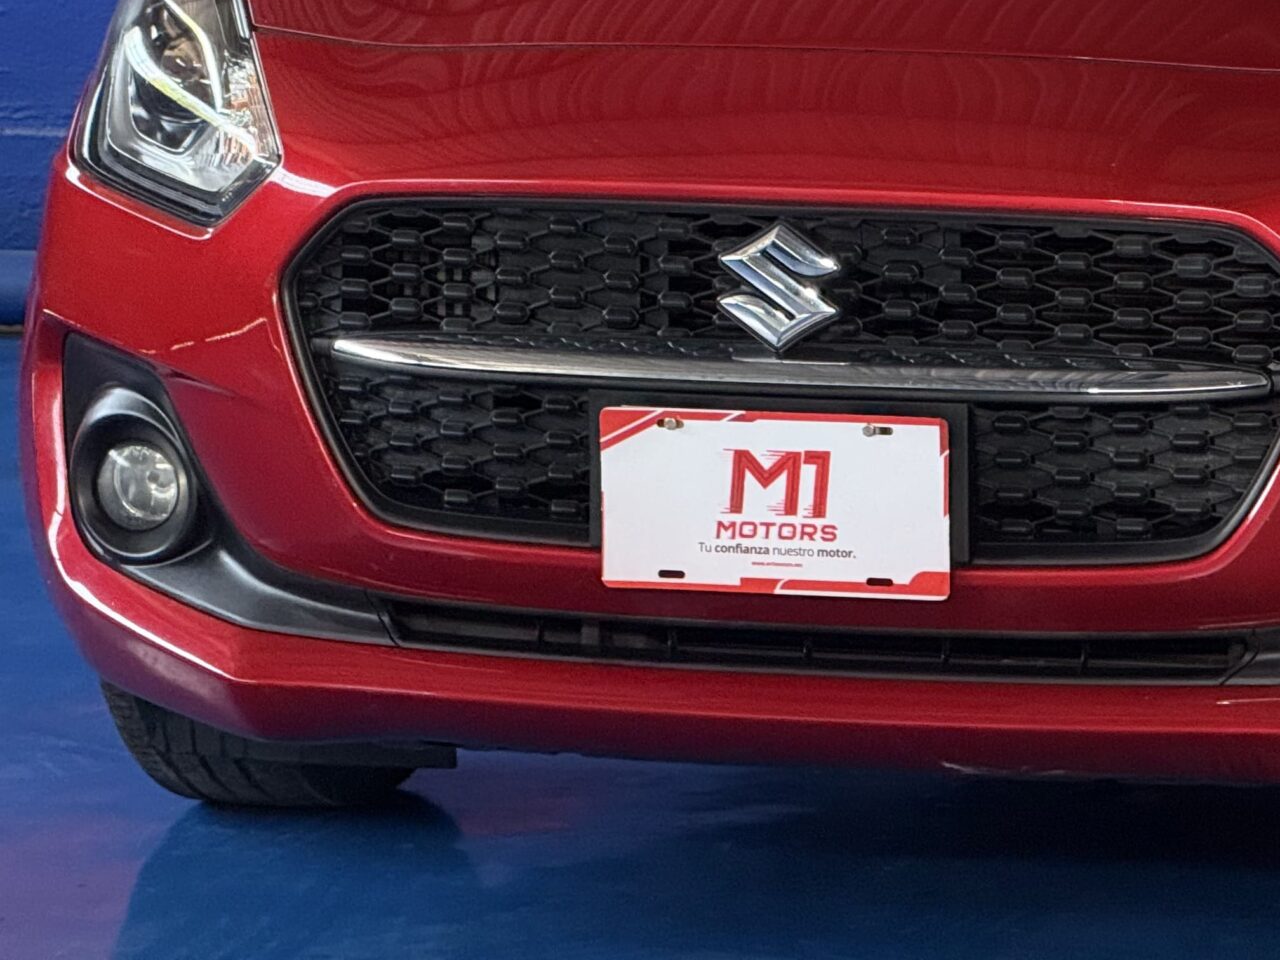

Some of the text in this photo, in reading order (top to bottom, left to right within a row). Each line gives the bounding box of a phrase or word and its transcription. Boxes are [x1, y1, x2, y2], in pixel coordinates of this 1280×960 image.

[723, 448, 832, 518] M1
[715, 520, 838, 542] MOTORS
[698, 542, 857, 559] Tu confianza nuestro motor.
